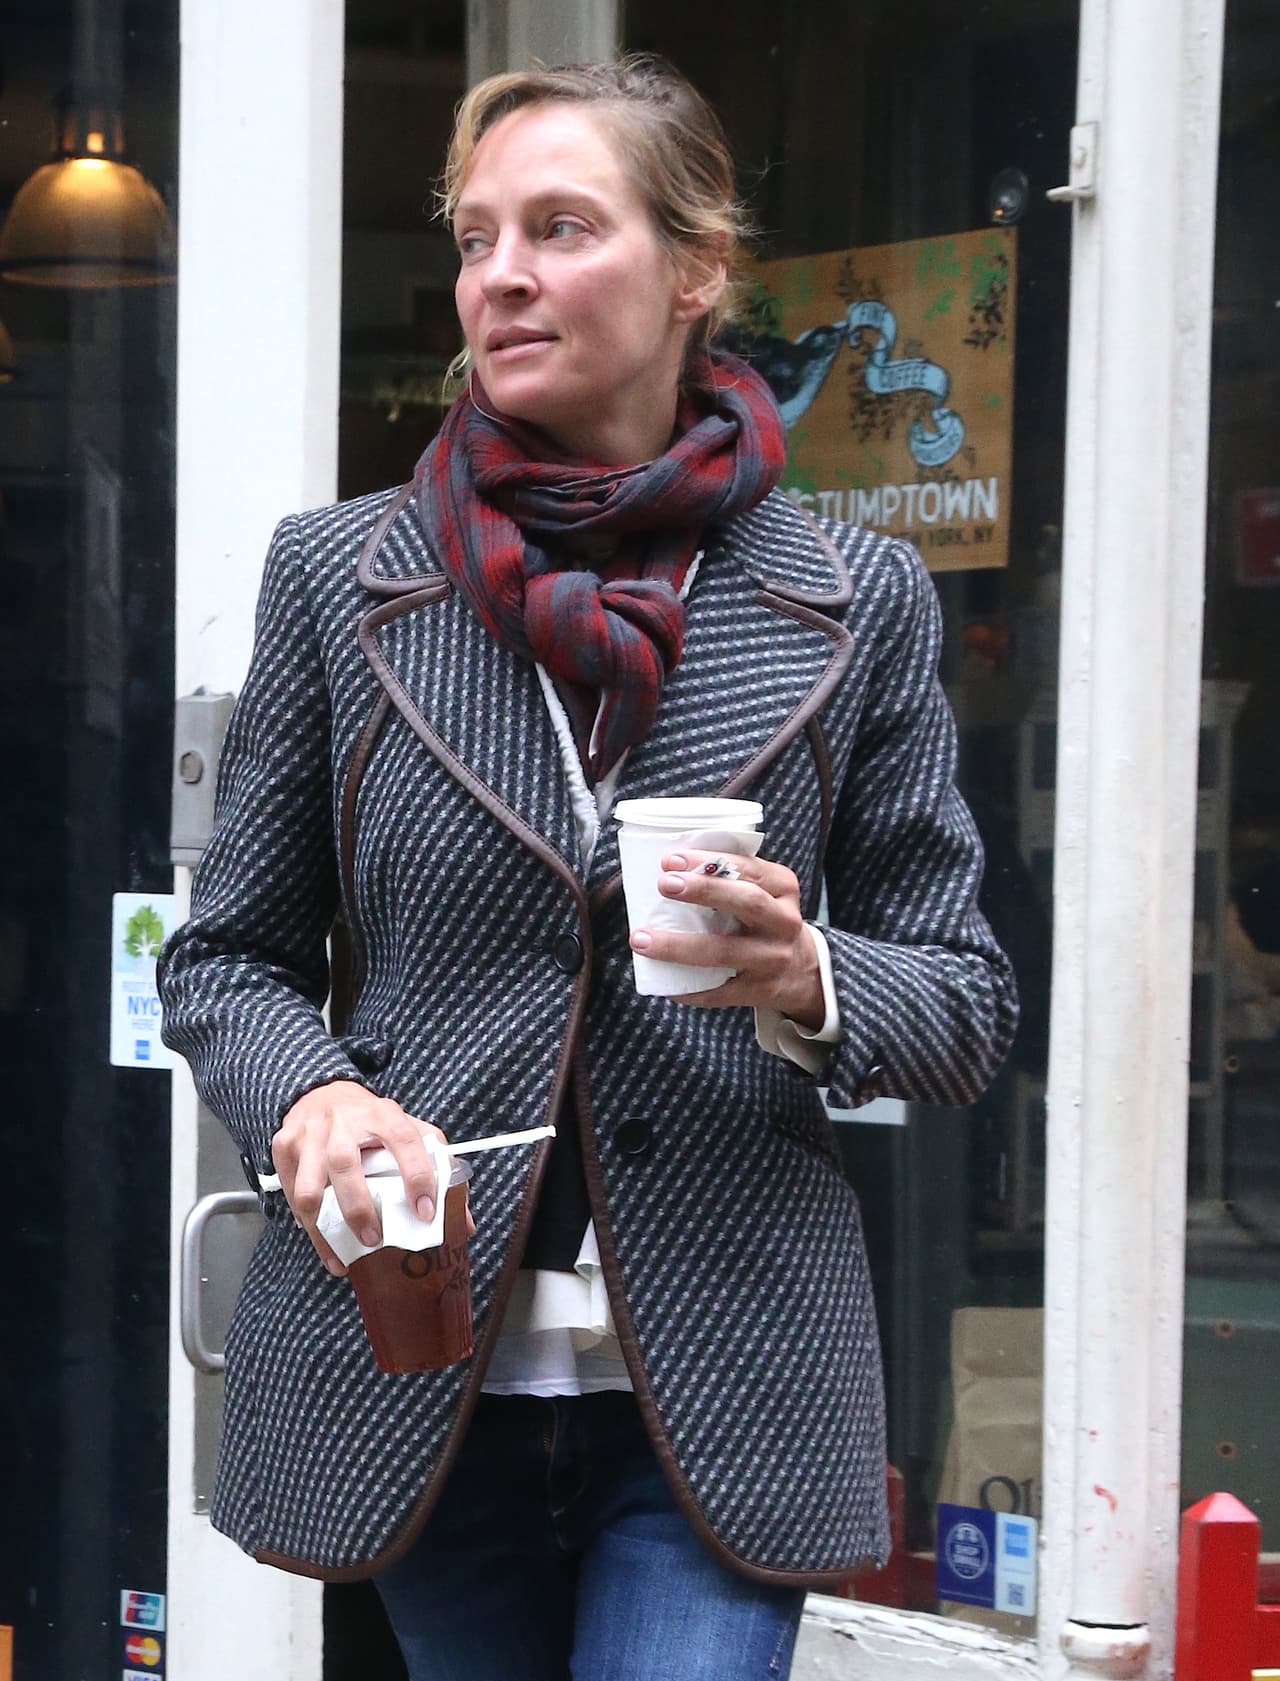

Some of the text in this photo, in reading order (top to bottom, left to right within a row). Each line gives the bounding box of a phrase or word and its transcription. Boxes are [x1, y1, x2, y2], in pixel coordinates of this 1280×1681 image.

[878, 361, 927, 386] COFFEE
[127, 996, 161, 1017] NYC
[979, 1475, 1042, 1517] Ol
